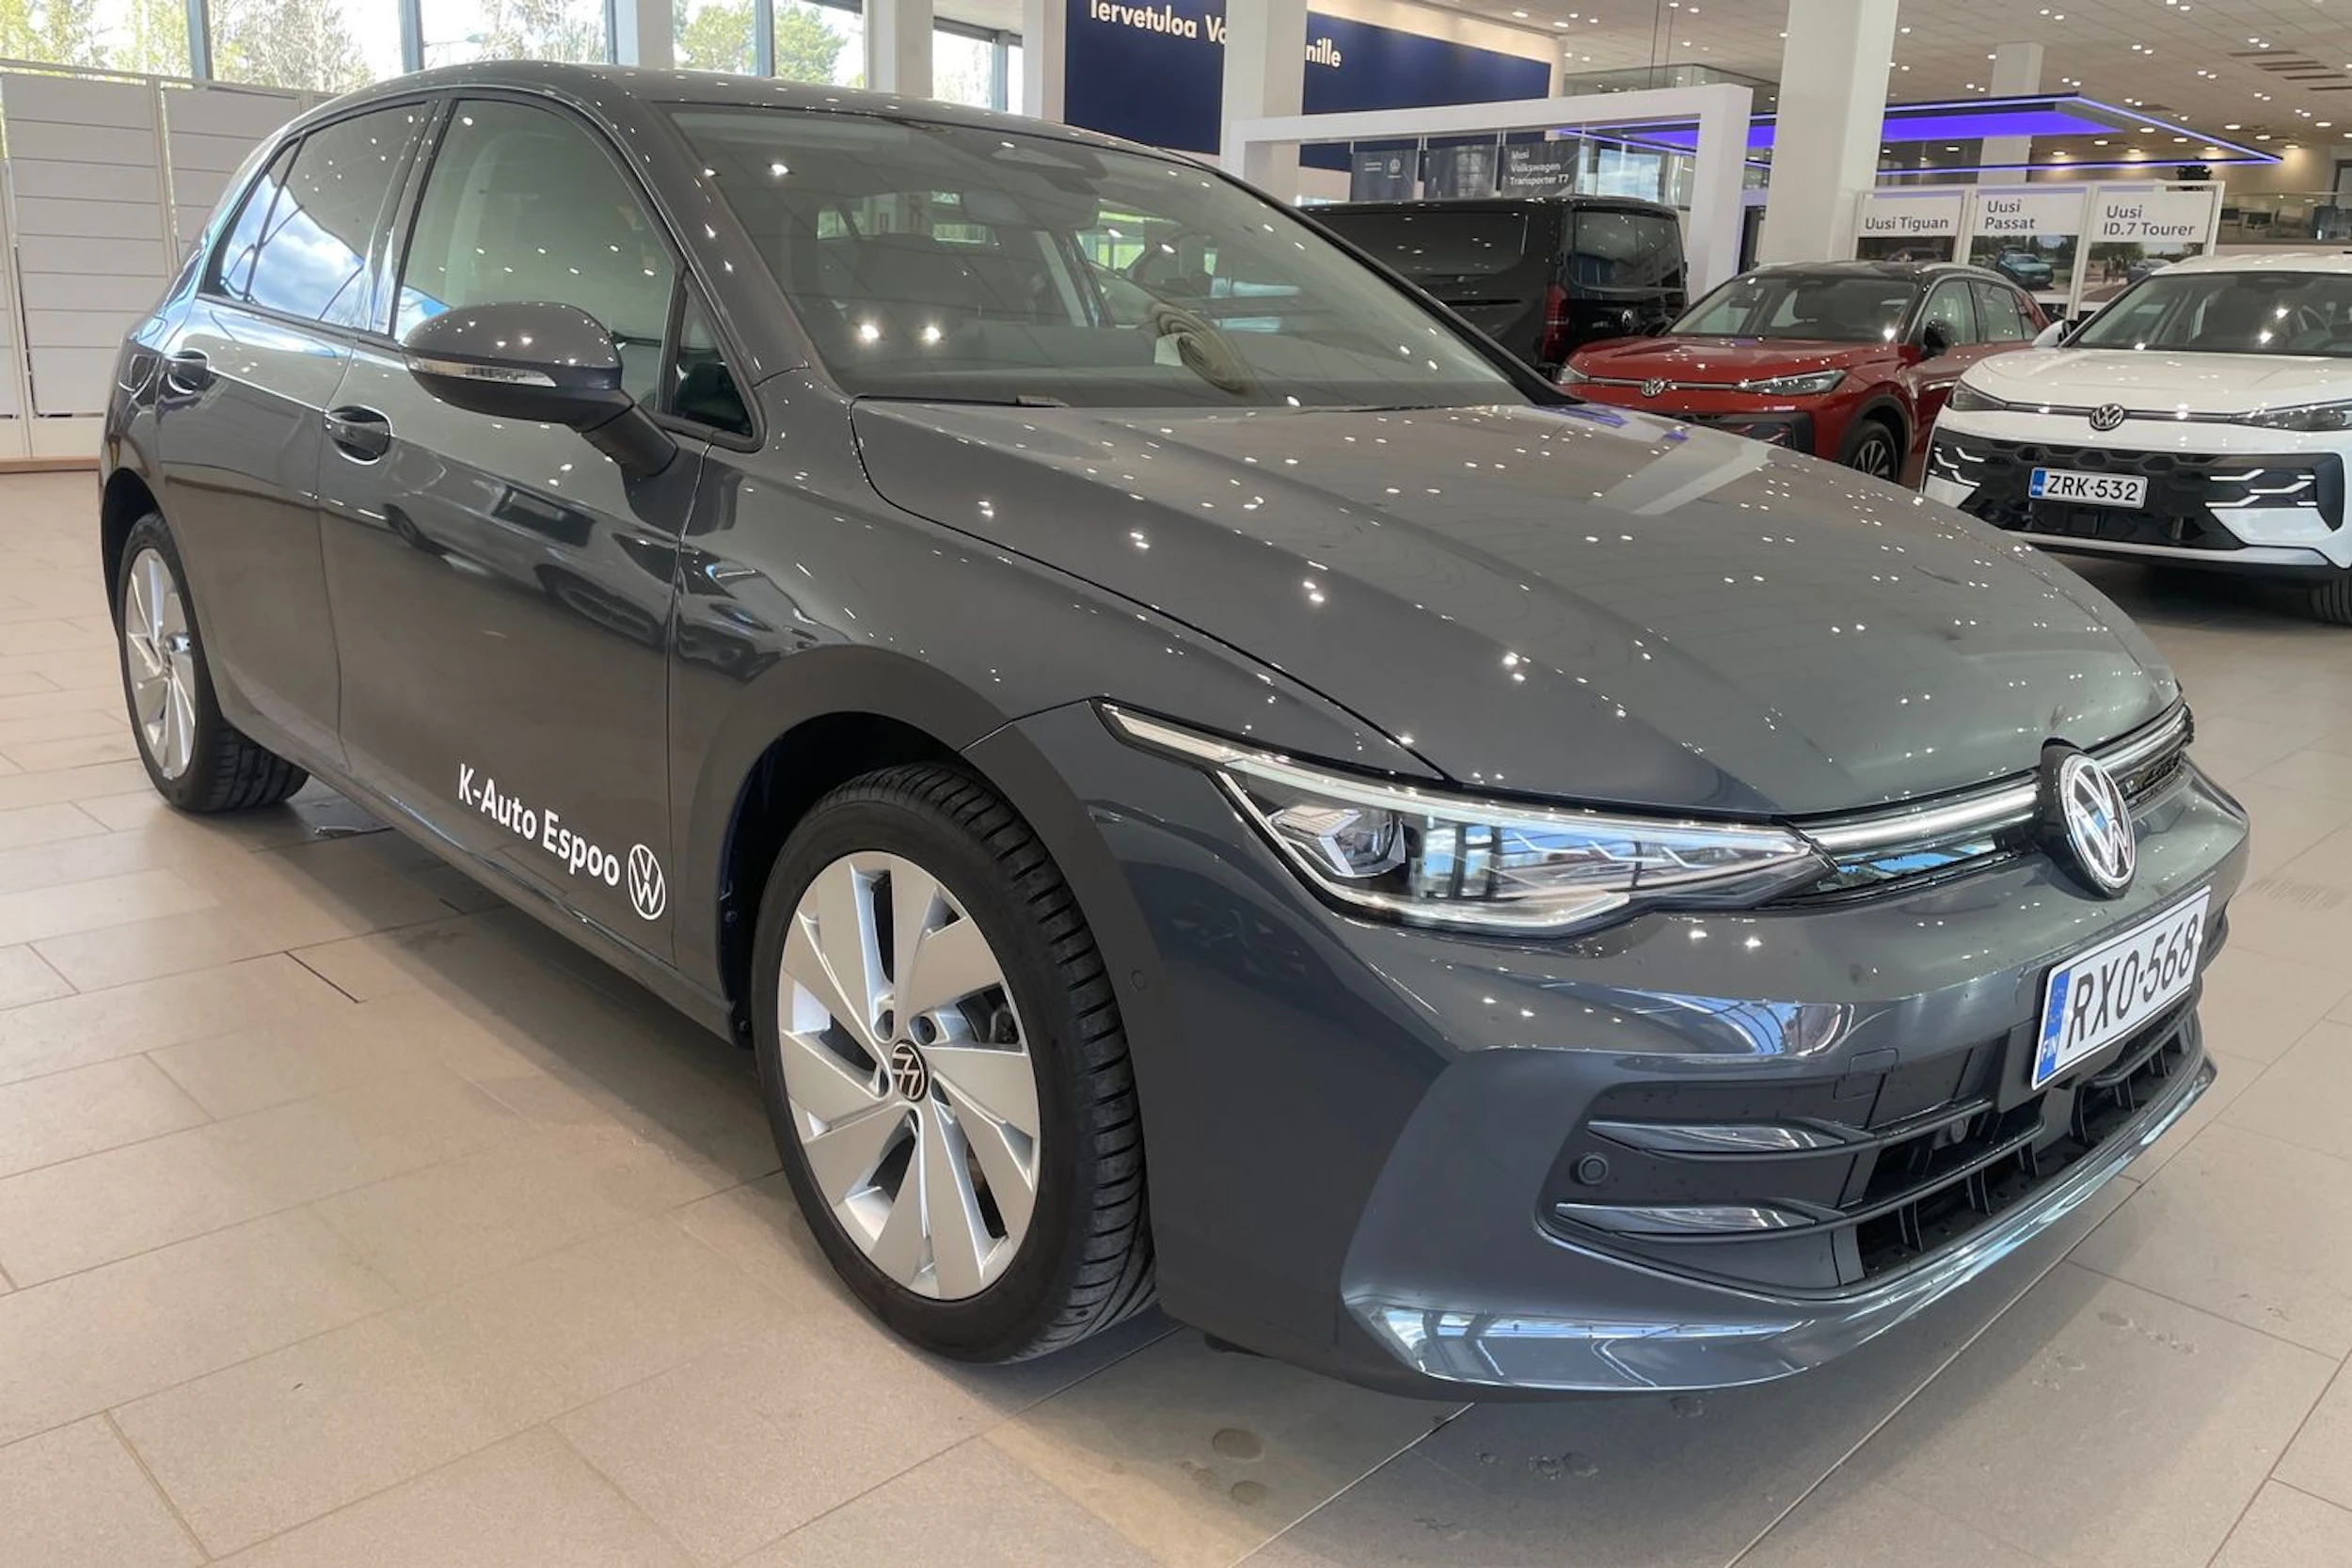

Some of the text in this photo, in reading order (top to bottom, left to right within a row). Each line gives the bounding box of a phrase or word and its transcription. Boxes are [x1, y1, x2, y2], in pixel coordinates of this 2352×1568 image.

[1987, 199, 2021, 214] Uusi
[2106, 204, 2143, 219] Uusi
[1865, 215, 1949, 233] Uusi Tiguan
[1984, 216, 2036, 230] Passat
[2103, 222, 2196, 237] ID.7 Tourer
[2047, 475, 2138, 501] ZRK-532
[458, 763, 620, 886] K-Auto Espoo
[2066, 912, 2199, 1049] RXO-568
